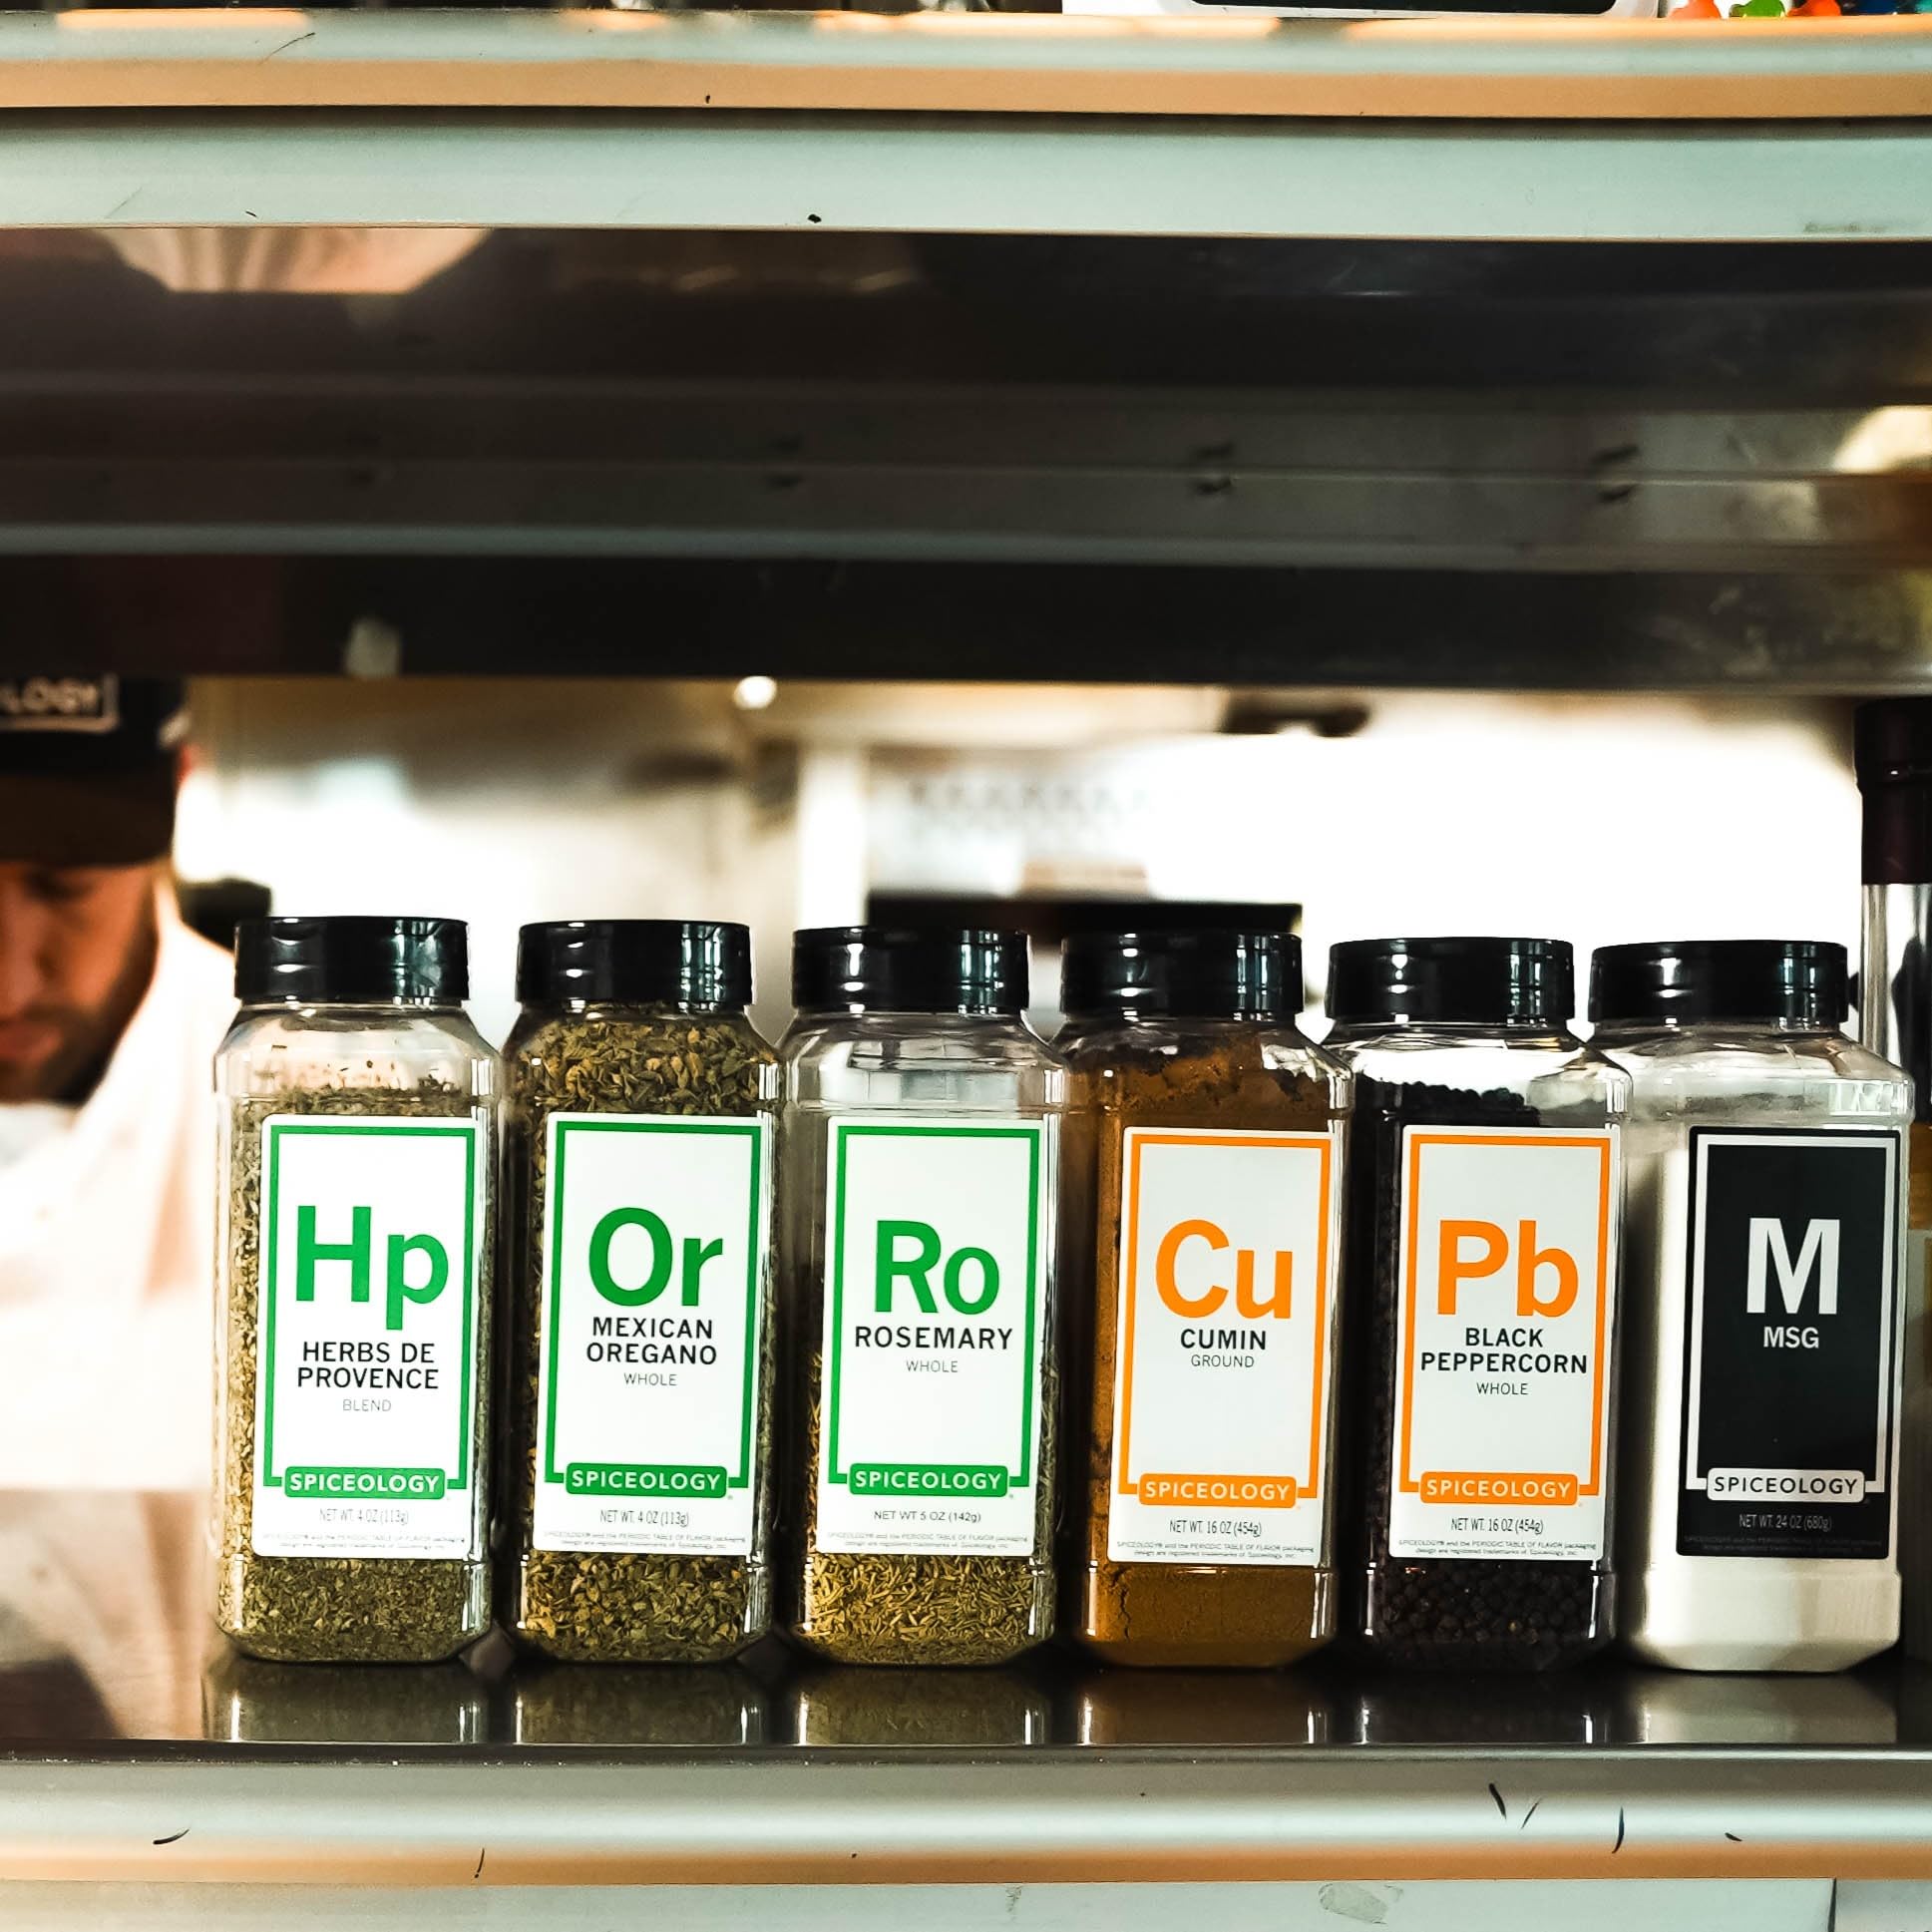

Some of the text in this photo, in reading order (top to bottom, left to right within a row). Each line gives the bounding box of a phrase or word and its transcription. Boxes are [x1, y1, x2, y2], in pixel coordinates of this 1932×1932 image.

[588, 1207, 723, 1307] Or
[1746, 1217, 1840, 1315] M
[296, 1205, 449, 1331] Hp
[875, 1220, 999, 1316] Ro
[1156, 1219, 1293, 1320] Cu
[1437, 1220, 1579, 1318] Pb
[592, 1317, 713, 1340] MEXICAN
[855, 1326, 1013, 1350] ROSEMARY
[1465, 1328, 1544, 1348] BLACK
[1762, 1326, 1820, 1349] MSG
[1180, 1329, 1267, 1351] CUMIN
[302, 1341, 435, 1363] HERBS DE
[586, 1343, 717, 1364] OREGANO
[1190, 1354, 1255, 1368] GROUND
[906, 1359, 959, 1373] WHOLE
[1420, 1352, 1588, 1374] PEPPERCORN
[297, 1367, 439, 1389] PROVENCE
[623, 1372, 678, 1386] WHOLE
[1476, 1382, 1529, 1395] WHOLE
[342, 1398, 392, 1412] BLEND
[289, 1472, 440, 1493] SPICEOLOGY
[572, 1470, 721, 1491] SPICEOLOGY
[855, 1471, 1001, 1490] SPICEOLOGY
[1426, 1478, 1571, 1498] SPICEOLOGY
[1714, 1476, 1857, 1494] SPICEOLOGY
[1145, 1481, 1290, 1501] SPICEOLOGY
[319, 1508, 337, 1523] NET
[357, 1509, 364, 1523] 4
[365, 1509, 378, 1524] OZ
[380, 1510, 410, 1526] (113g)
[599, 1509, 618, 1524] NET
[637, 1510, 644, 1524] 4
[645, 1510, 658, 1525] OZ
[660, 1511, 689, 1527] (113g)
[874, 1510, 981, 1524] NET WT 5 OZ (142g)
[1451, 1517, 1468, 1531] NET
[1488, 1518, 1499, 1532] 16
[1501, 1519, 1513, 1532] OZ
[1515, 1518, 1543, 1535] (454g)
[1739, 1513, 1756, 1528] NET
[1775, 1514, 1787, 1529] 24
[1789, 1515, 1802, 1530] OZ
[1803, 1515, 1832, 1532] (680g)
[1169, 1519, 1187, 1533] NET
[1206, 1520, 1217, 1534] 16
[1220, 1521, 1232, 1535] OZ
[1233, 1521, 1262, 1538] (454g)
